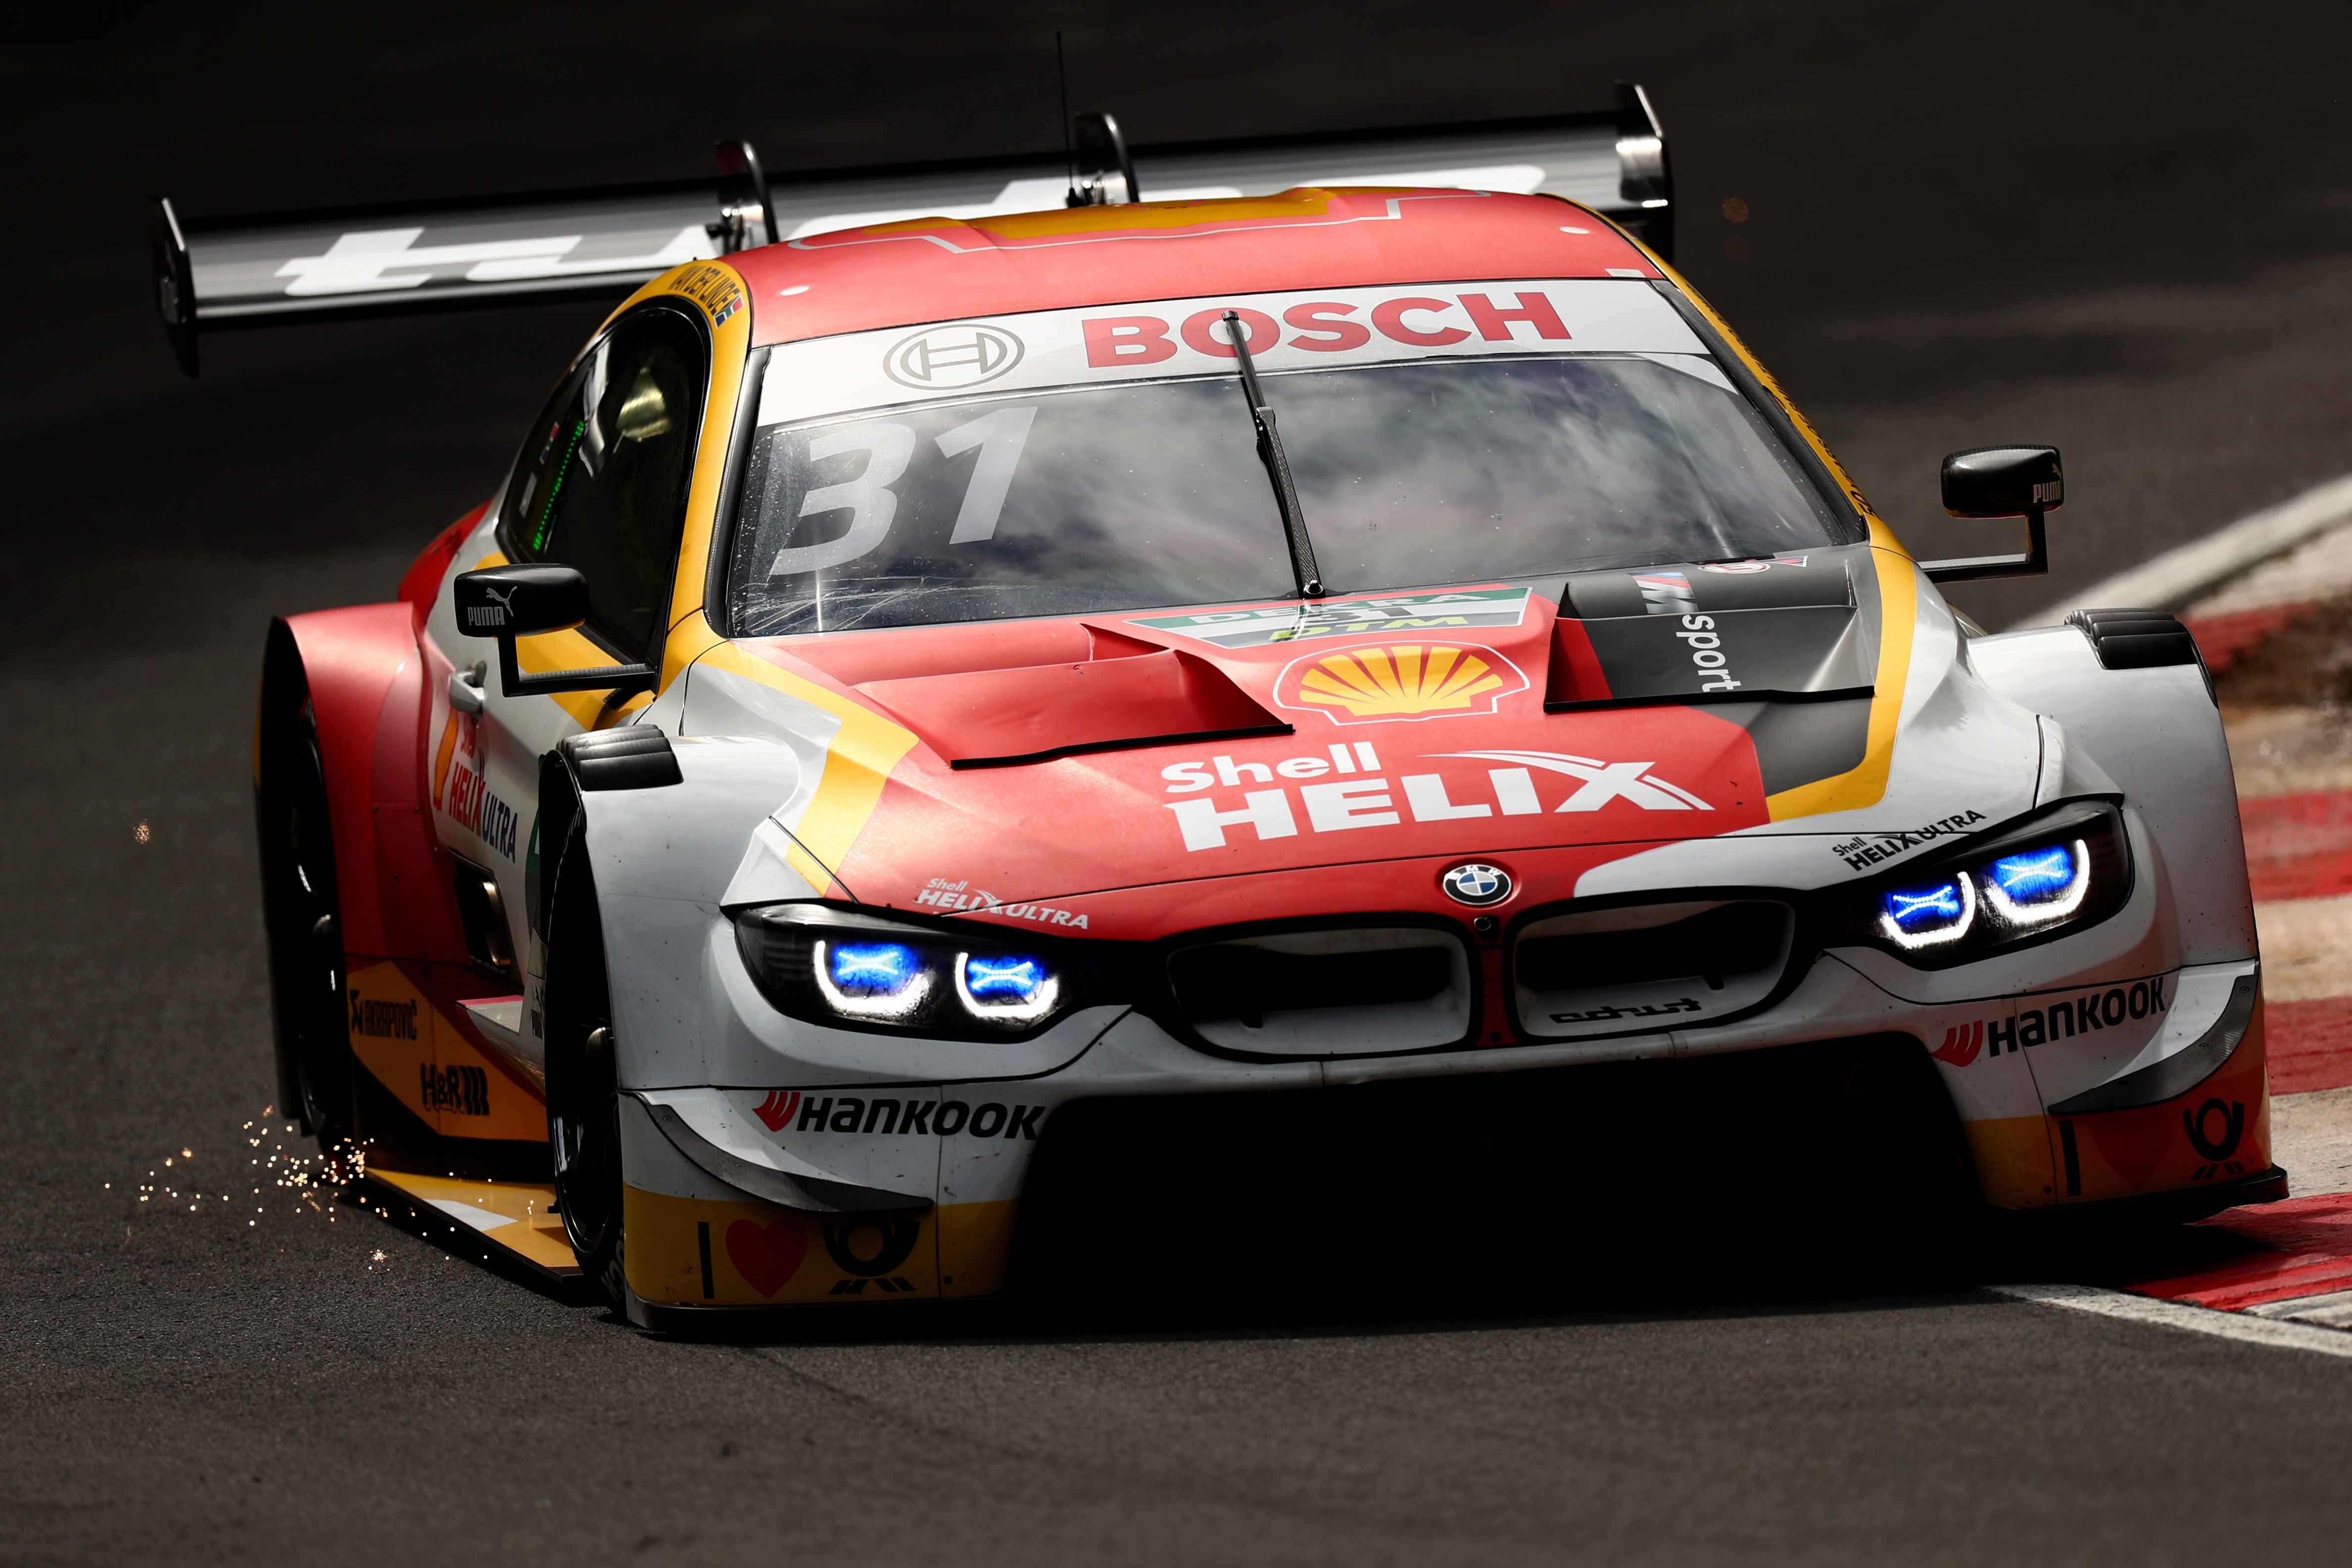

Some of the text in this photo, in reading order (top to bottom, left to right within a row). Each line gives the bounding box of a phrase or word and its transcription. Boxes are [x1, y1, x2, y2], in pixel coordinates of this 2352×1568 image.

[684, 267, 721, 297] DER
[699, 274, 740, 316] LINDE
[1081, 292, 1572, 368] BOSCH
[769, 406, 1038, 576] 31
[467, 606, 505, 626] PUMA
[1188, 594, 1491, 624] DEKRA
[1269, 617, 1469, 640] DTM
[1298, 607, 1414, 624] 31
[1675, 614, 1741, 692] sport
[1160, 741, 1382, 793] Shell
[449, 755, 487, 837] HELIX
[482, 791, 518, 864] ULTRA
[1163, 749, 1715, 852] HELIX
[1832, 836, 1868, 857] Shell
[1843, 810, 1987, 872] HELIX ULTRA
[927, 878, 968, 891] Shell
[1448, 865, 1502, 881] BMW
[915, 888, 1088, 930] HELIX ULTRA
[421, 1062, 464, 1112] H&R
